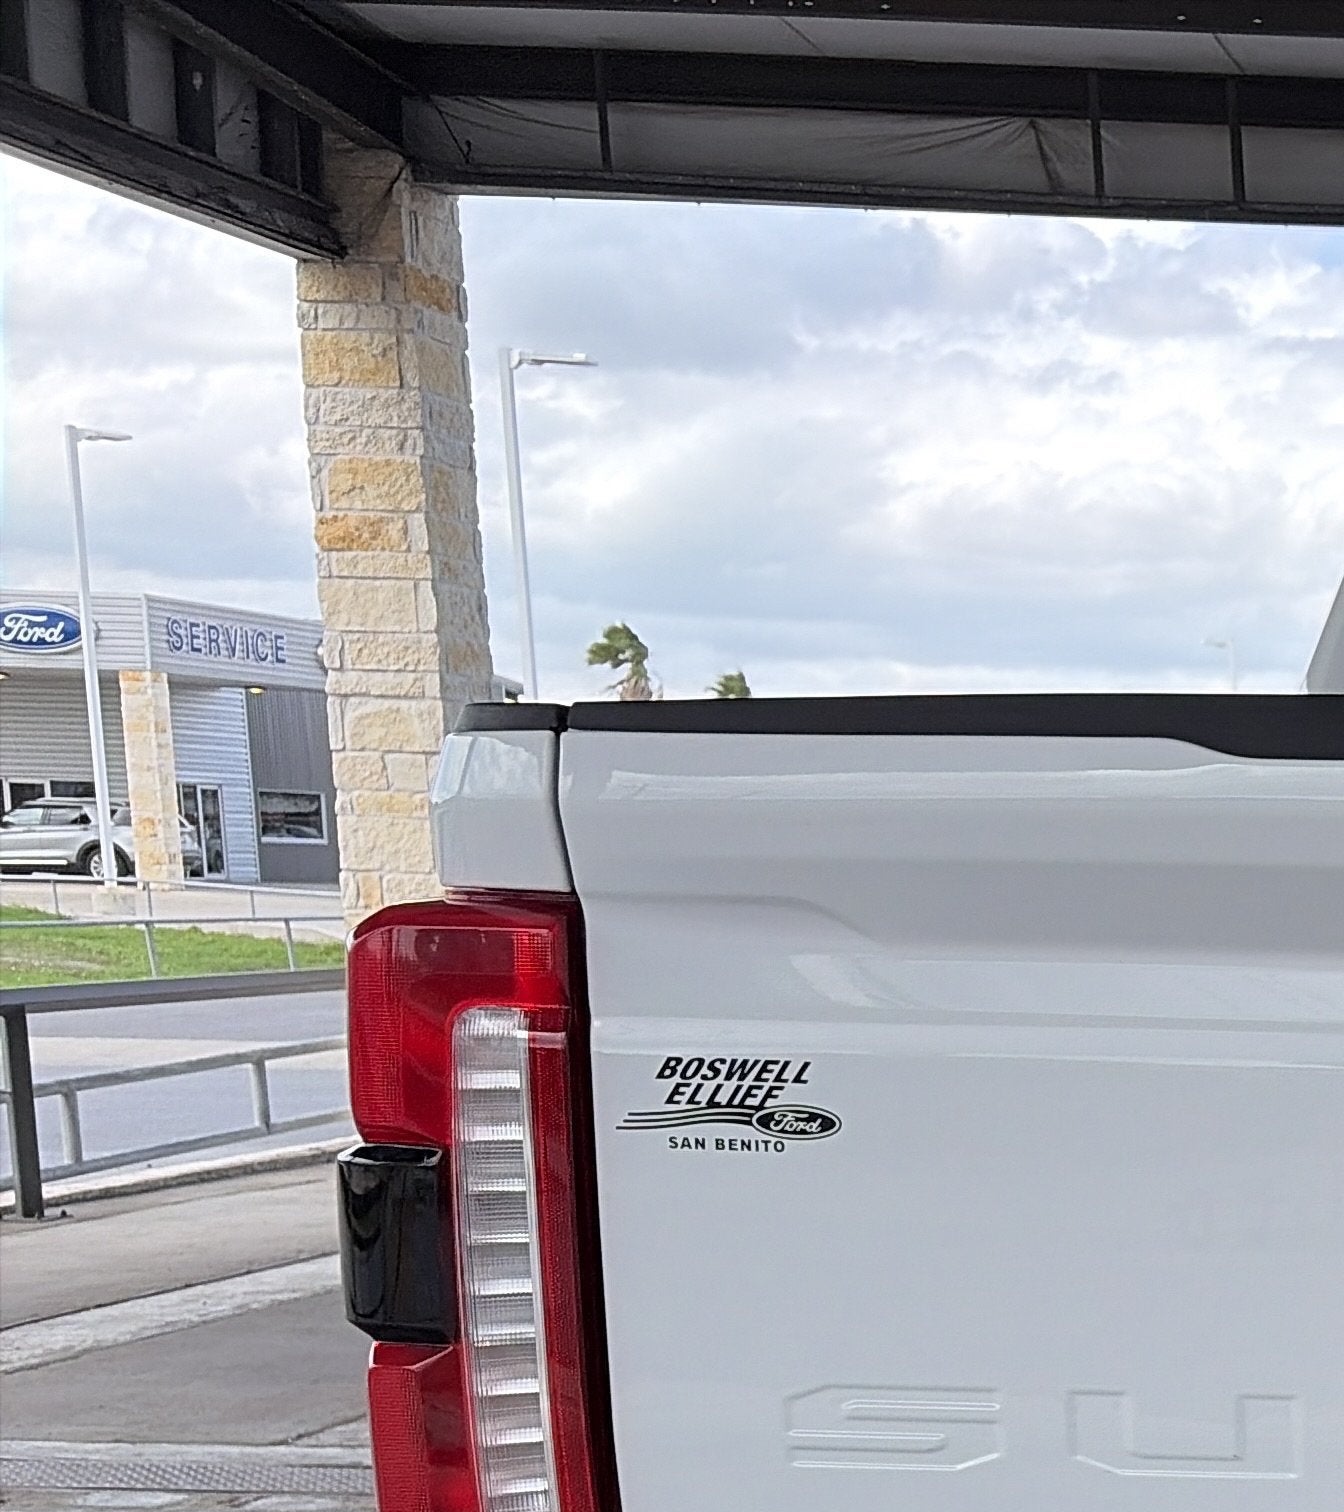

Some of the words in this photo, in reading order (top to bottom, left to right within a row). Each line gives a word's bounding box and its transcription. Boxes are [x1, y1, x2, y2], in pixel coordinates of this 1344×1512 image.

[0, 613, 66, 644] Ford
[168, 616, 287, 664] SERVICE
[655, 1056, 812, 1084] BOSWELL
[664, 1082, 785, 1107] ELLIFF
[769, 1112, 823, 1133] Ford
[668, 1136, 706, 1150] SAN
[714, 1138, 786, 1153] BENITO
